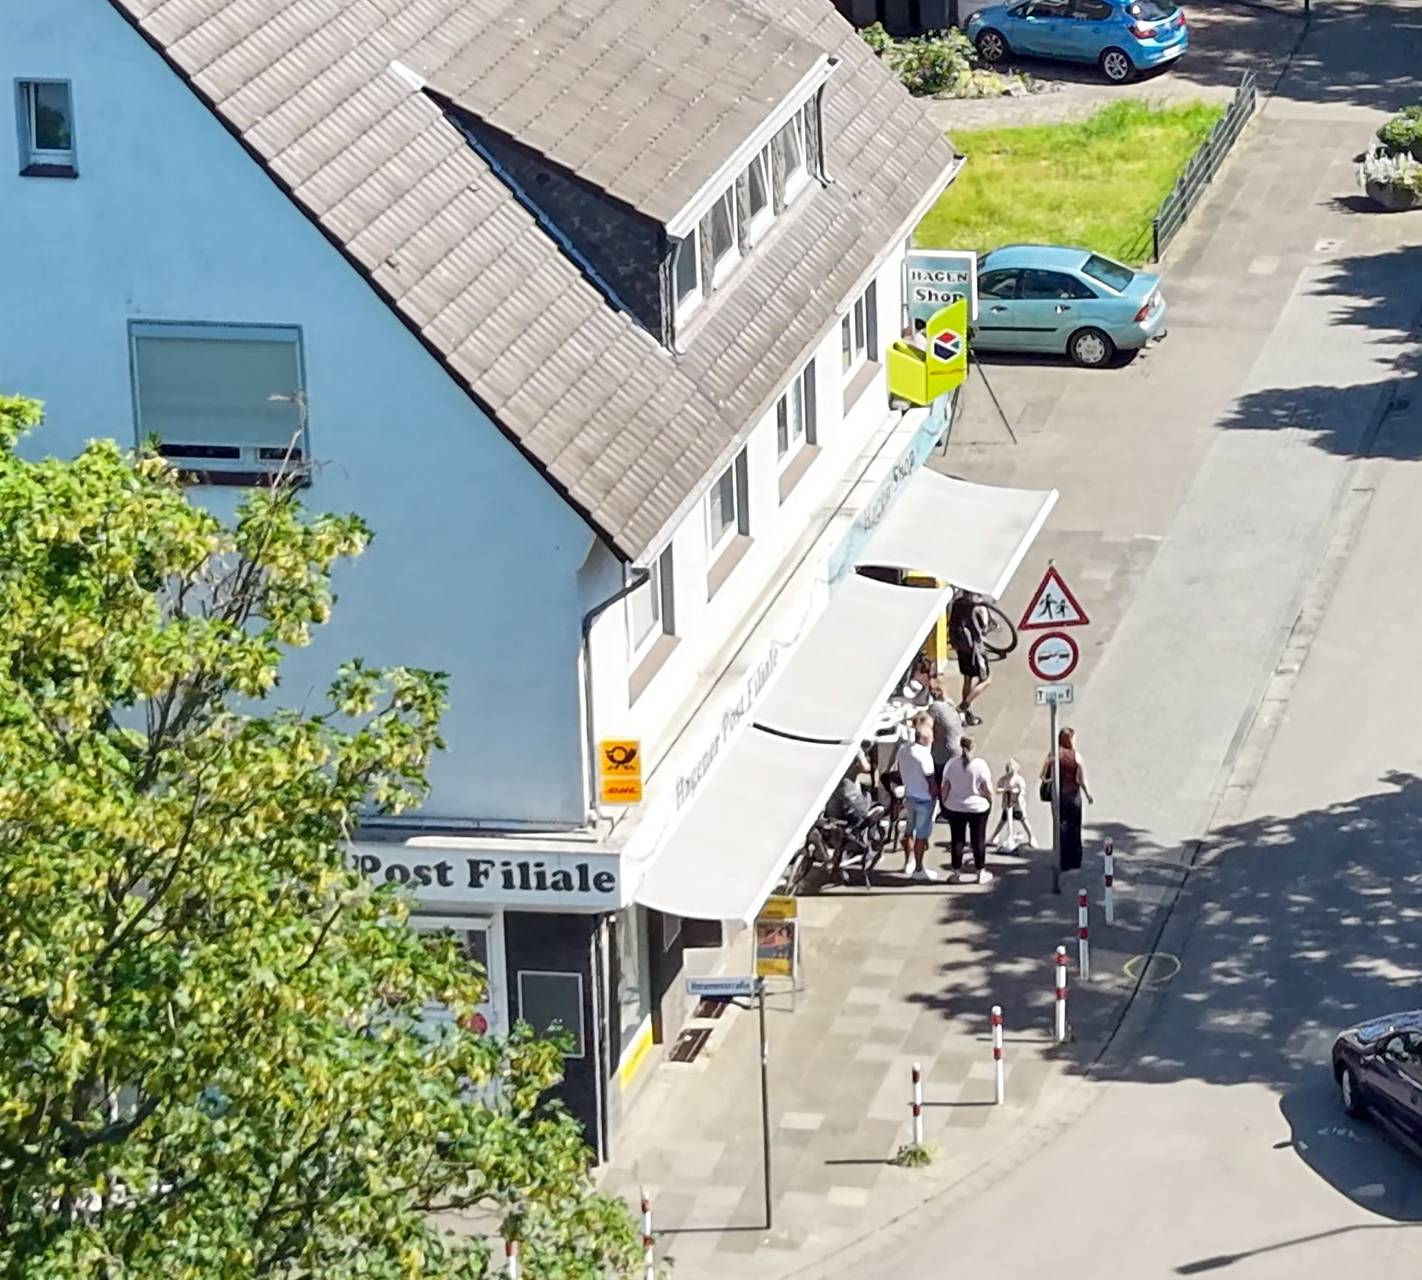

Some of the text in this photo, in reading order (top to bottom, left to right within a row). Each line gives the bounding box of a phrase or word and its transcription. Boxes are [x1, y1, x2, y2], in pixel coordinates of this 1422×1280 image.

[911, 271, 968, 282] HAGEN
[351, 854, 616, 893] Post Filiale
